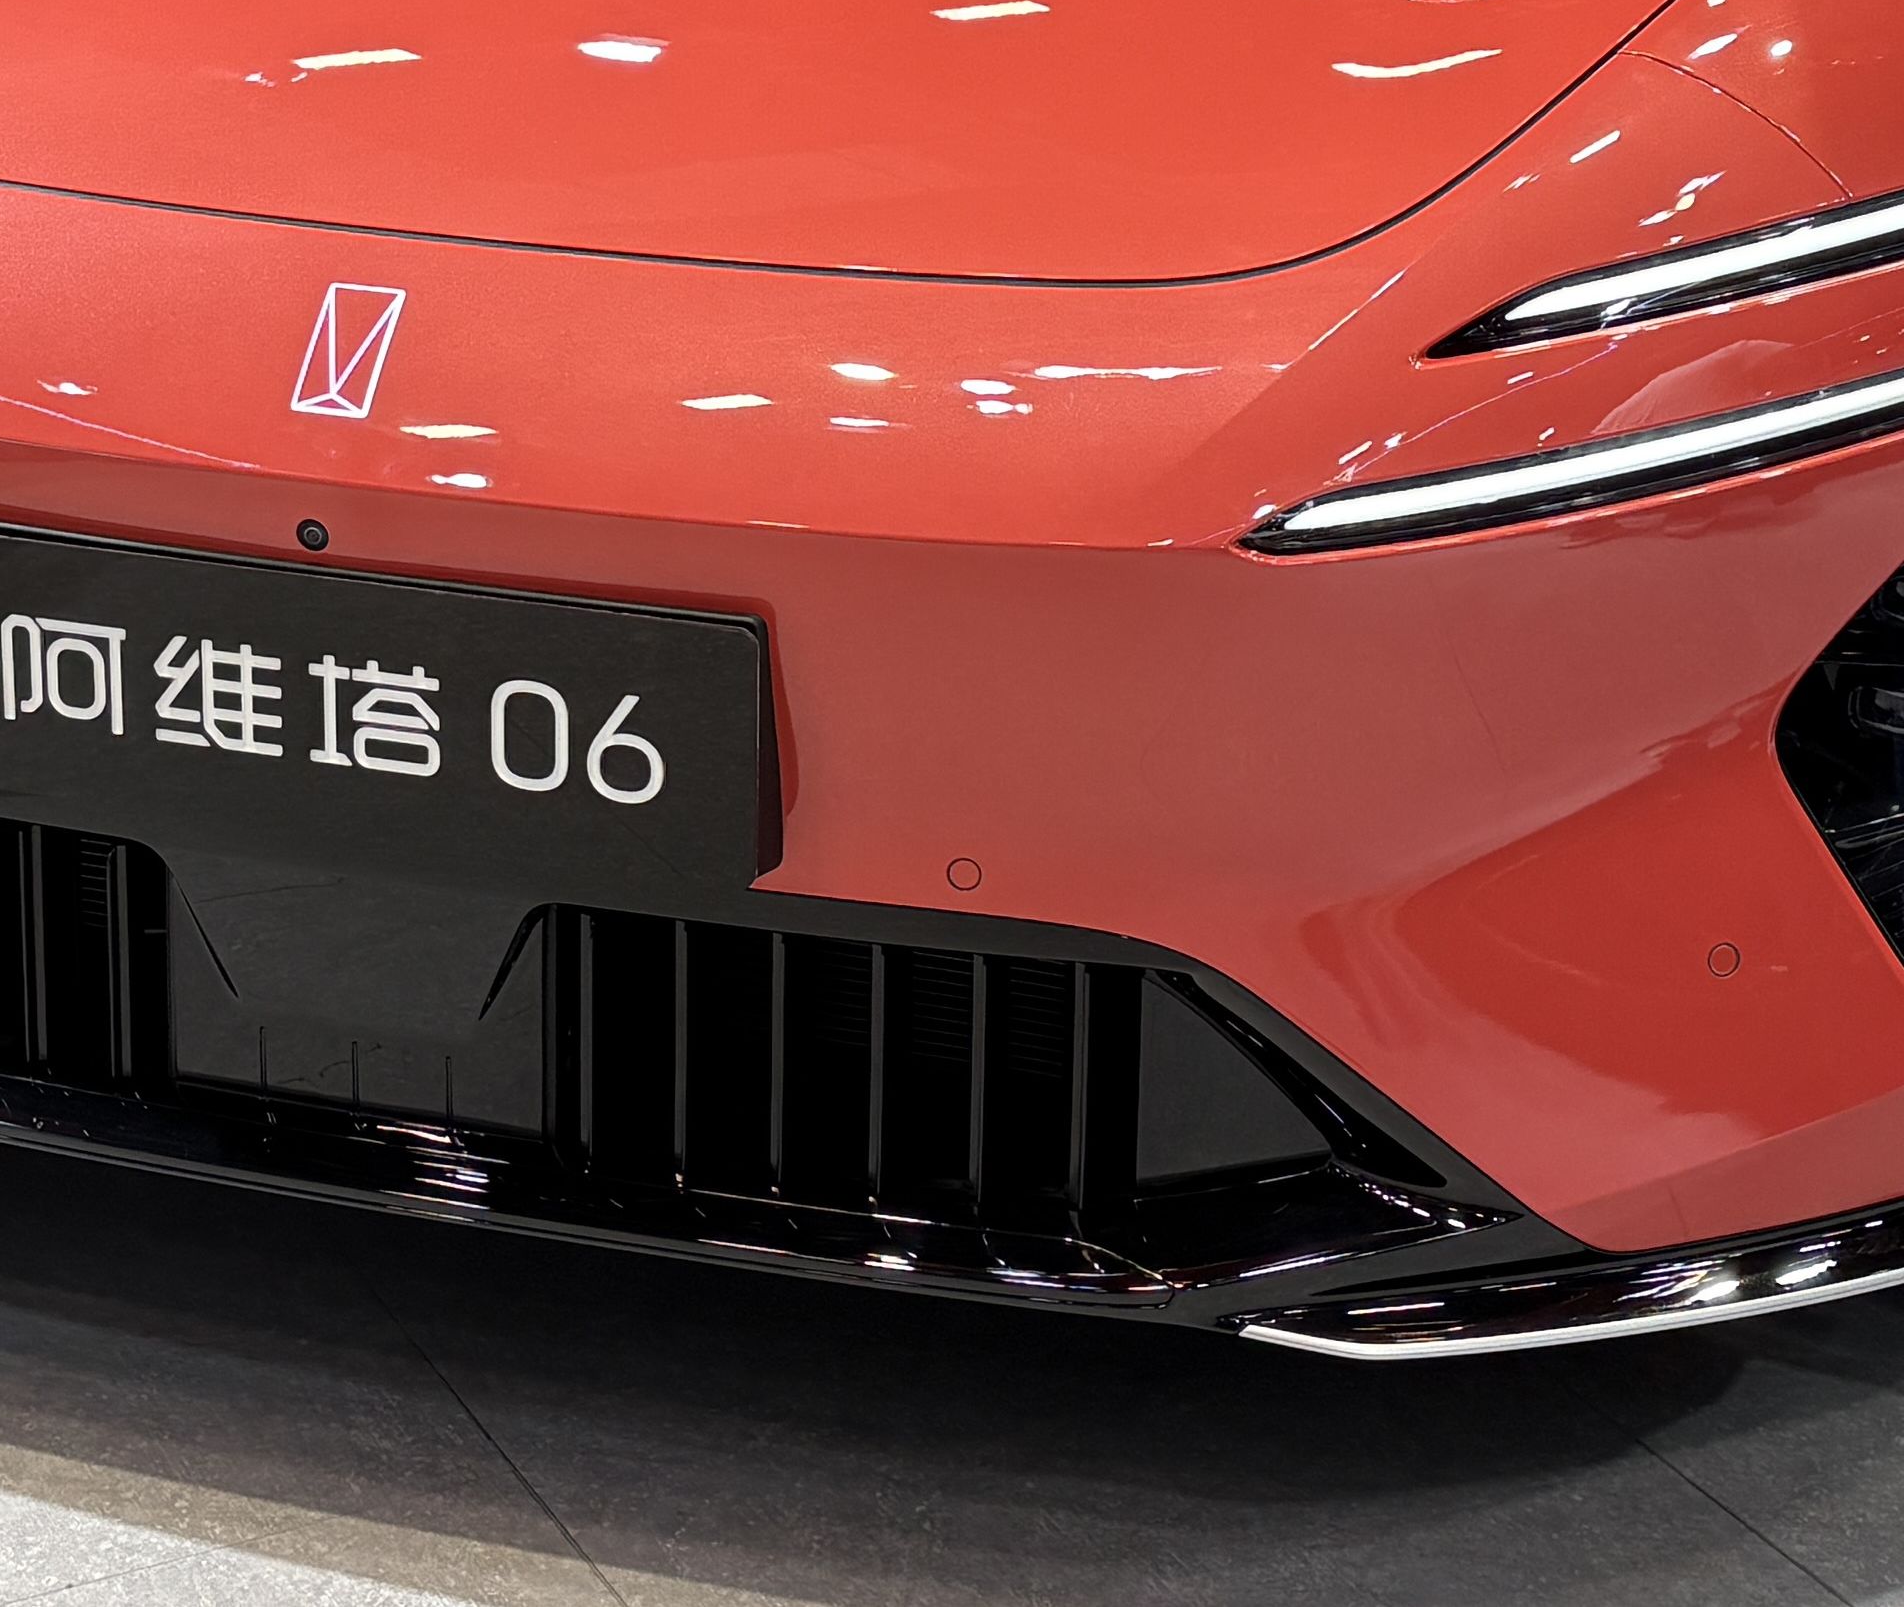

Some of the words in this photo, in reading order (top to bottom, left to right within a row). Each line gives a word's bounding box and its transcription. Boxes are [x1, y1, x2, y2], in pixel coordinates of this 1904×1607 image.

[0, 613, 441, 778] 阿维塔
[489, 679, 666, 805] 06
